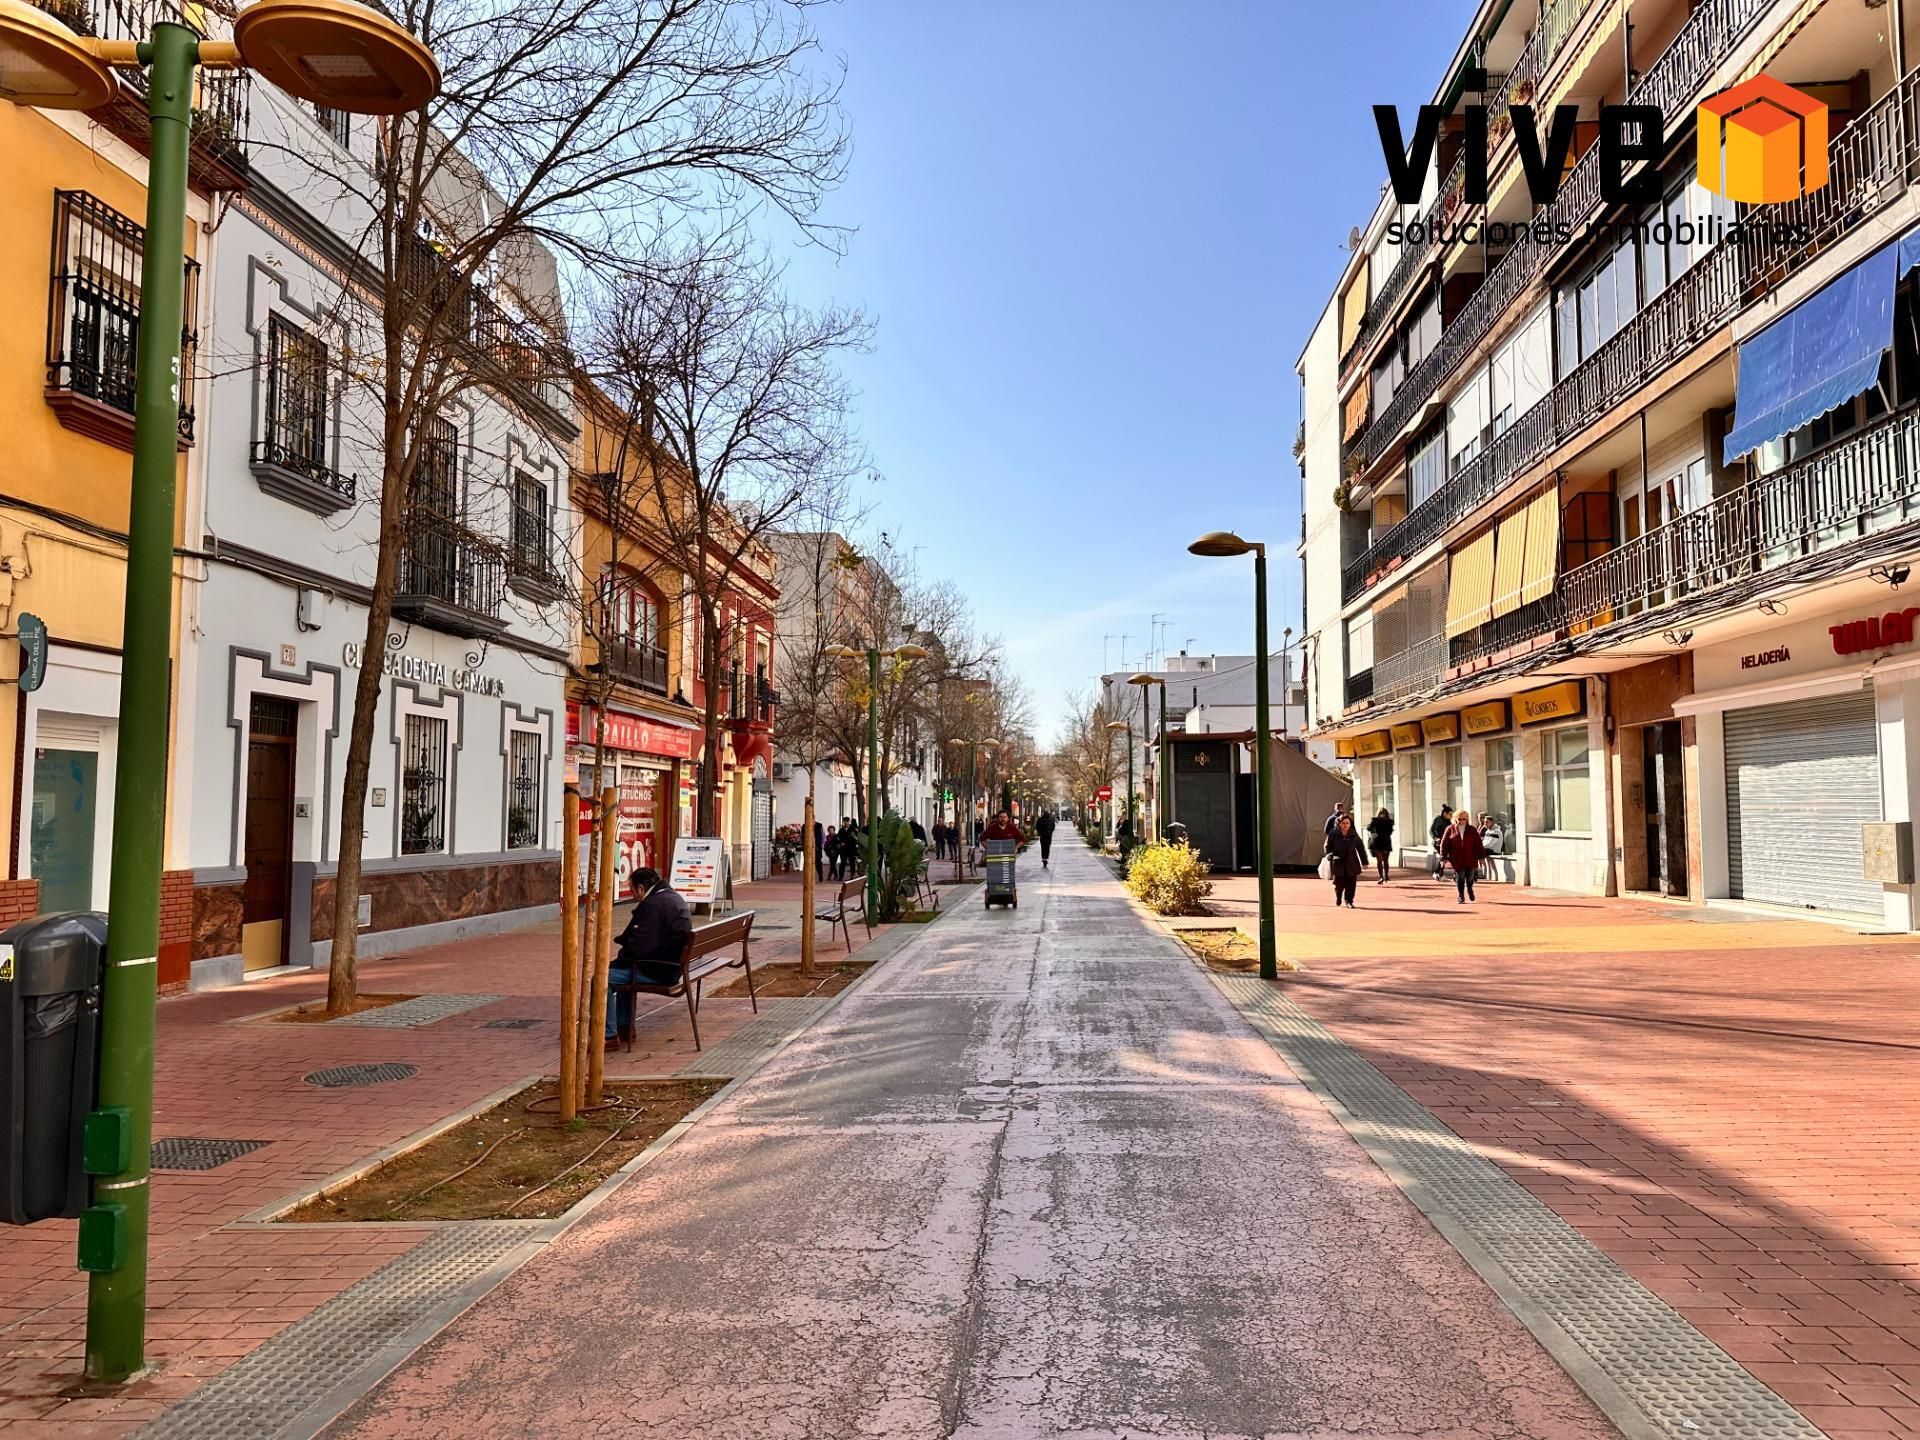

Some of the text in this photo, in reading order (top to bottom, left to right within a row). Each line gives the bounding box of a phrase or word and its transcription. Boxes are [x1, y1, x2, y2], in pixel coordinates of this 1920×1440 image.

[284, 648, 294, 661] 70
[1741, 644, 1791, 669] HELADERÍA
[402, 655, 449, 687] DENTAL
